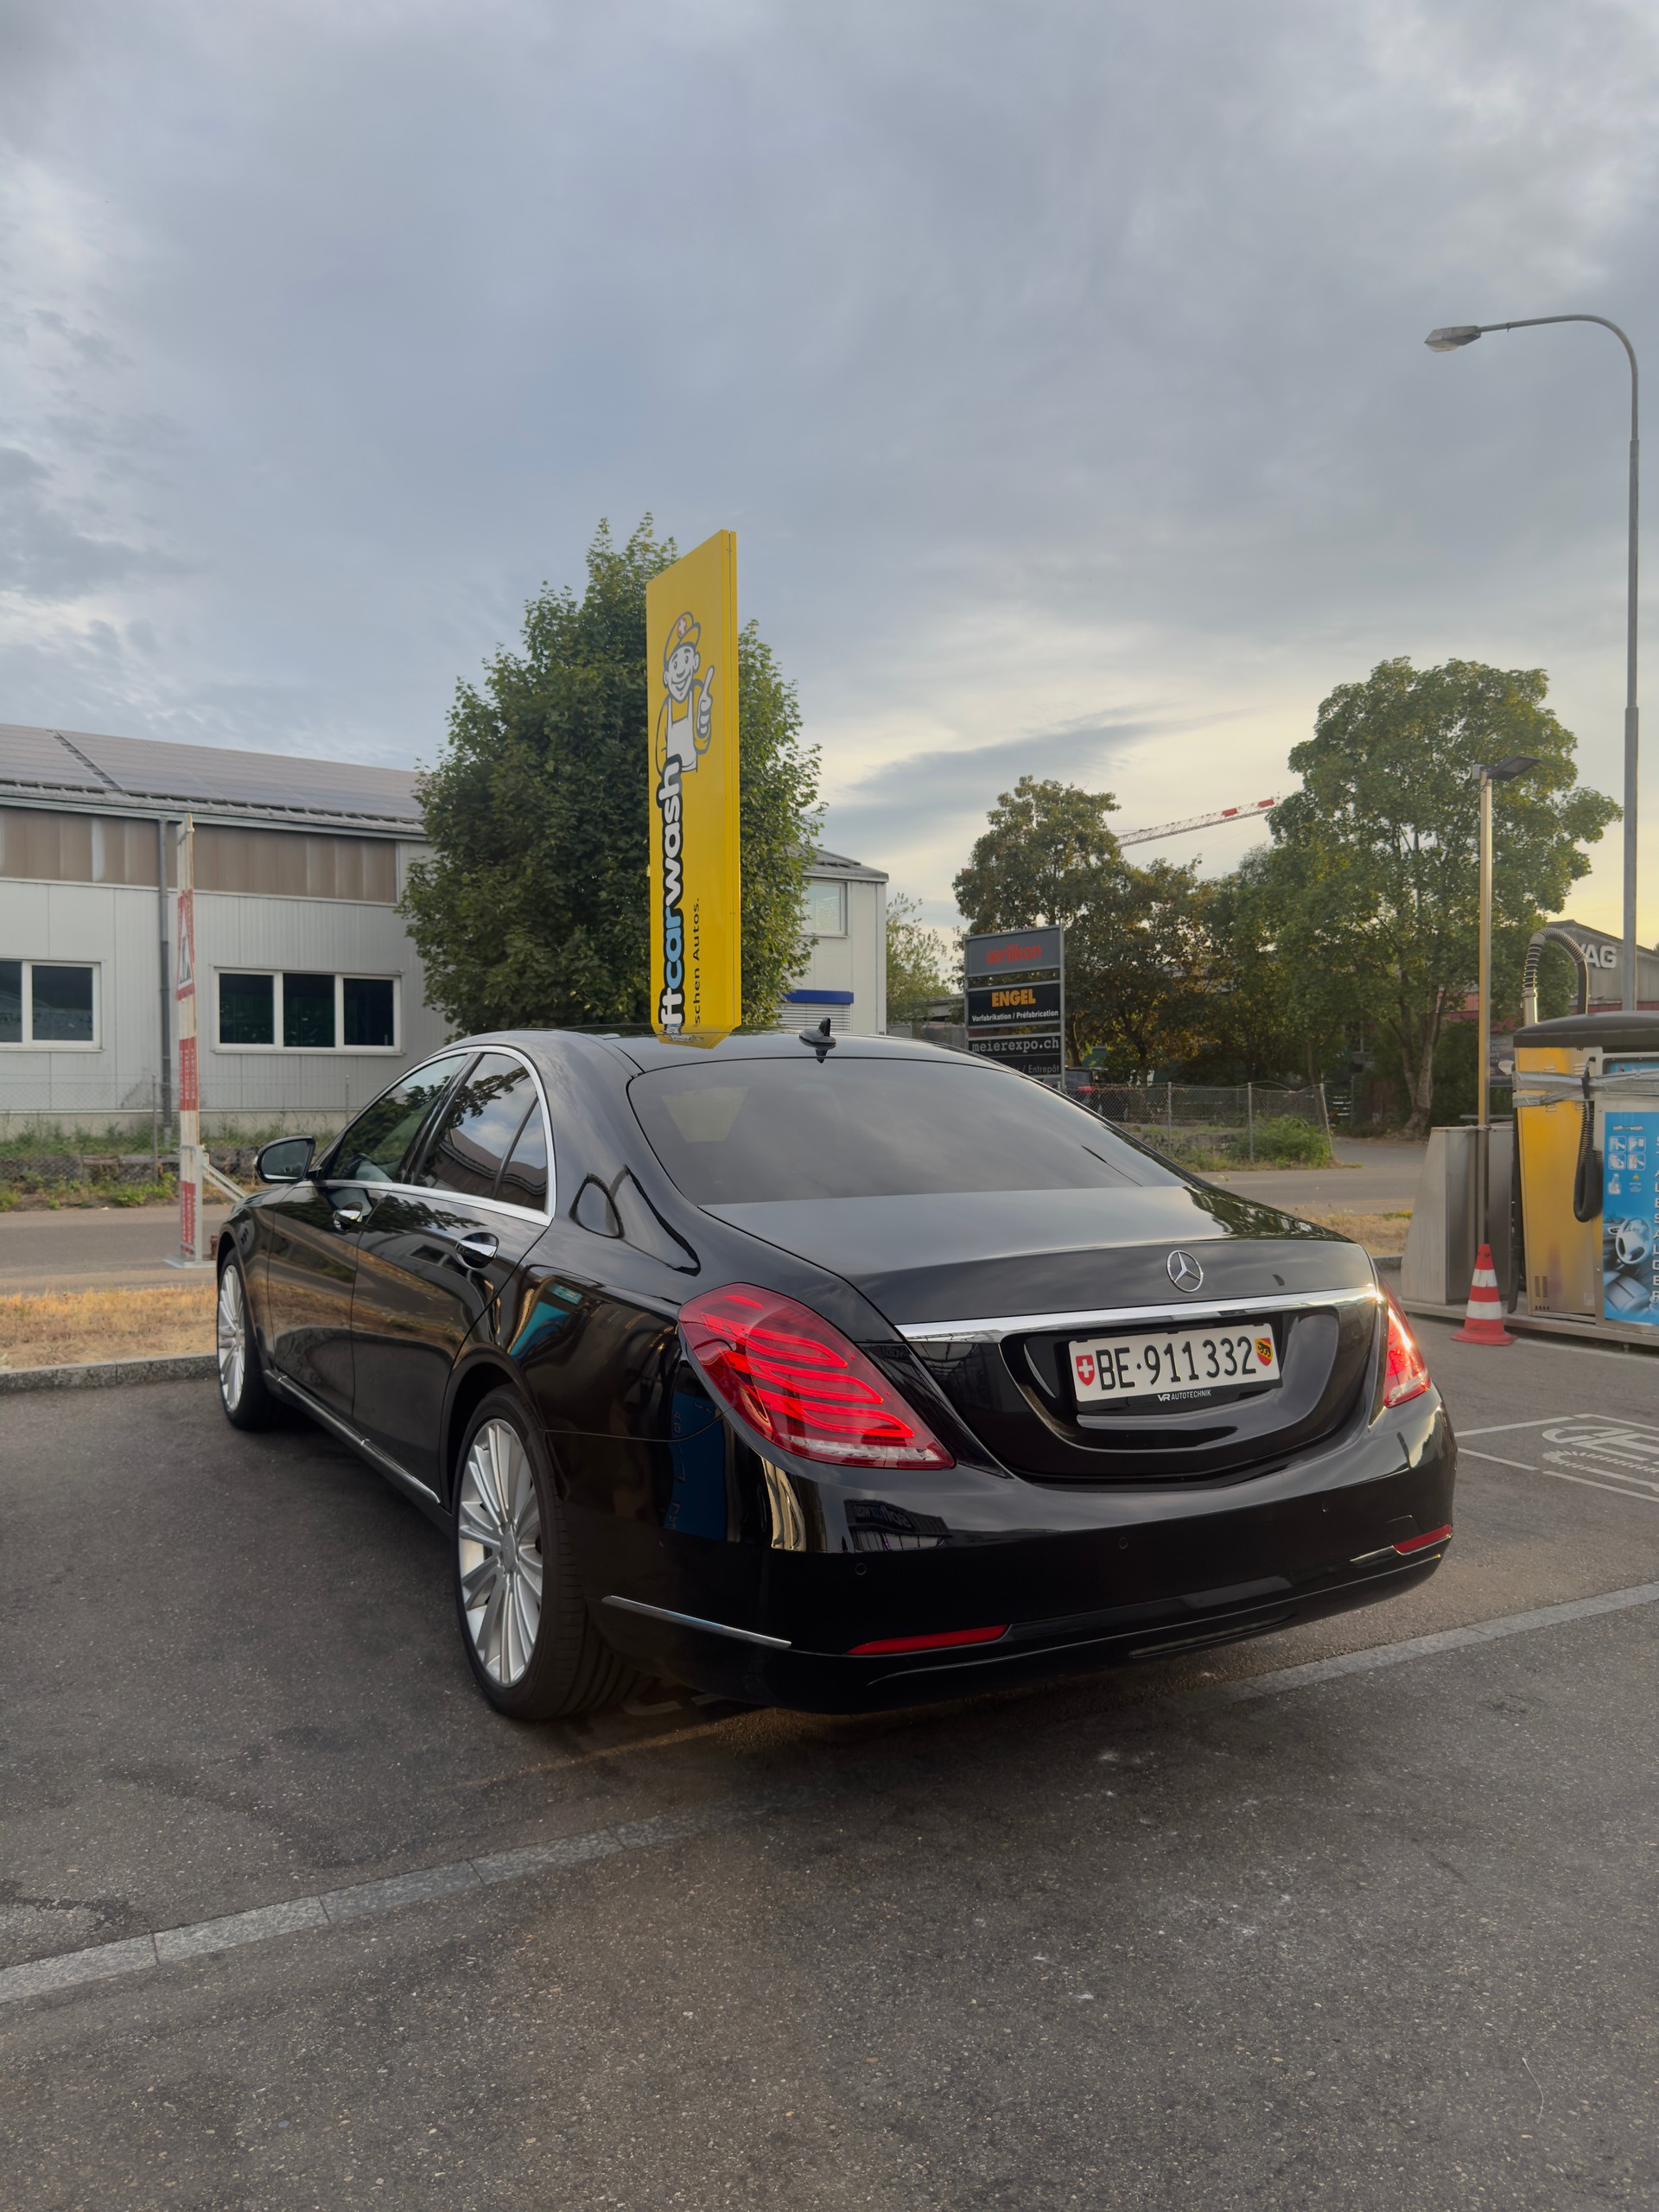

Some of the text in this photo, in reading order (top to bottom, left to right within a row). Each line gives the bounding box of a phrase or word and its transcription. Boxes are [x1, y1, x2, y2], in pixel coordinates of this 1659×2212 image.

[658, 761, 683, 1024] ftcarwash
[991, 988, 1036, 1007] ENGEL
[972, 1013, 1011, 1021] Vorfabrikation
[1016, 1009, 1058, 1019] Préfabrication
[972, 1037, 1059, 1052] meierexpo.ch
[1028, 1064, 1059, 1074] Entrepôt
[1171, 1389, 1211, 1400] AUTOTECHNIK
